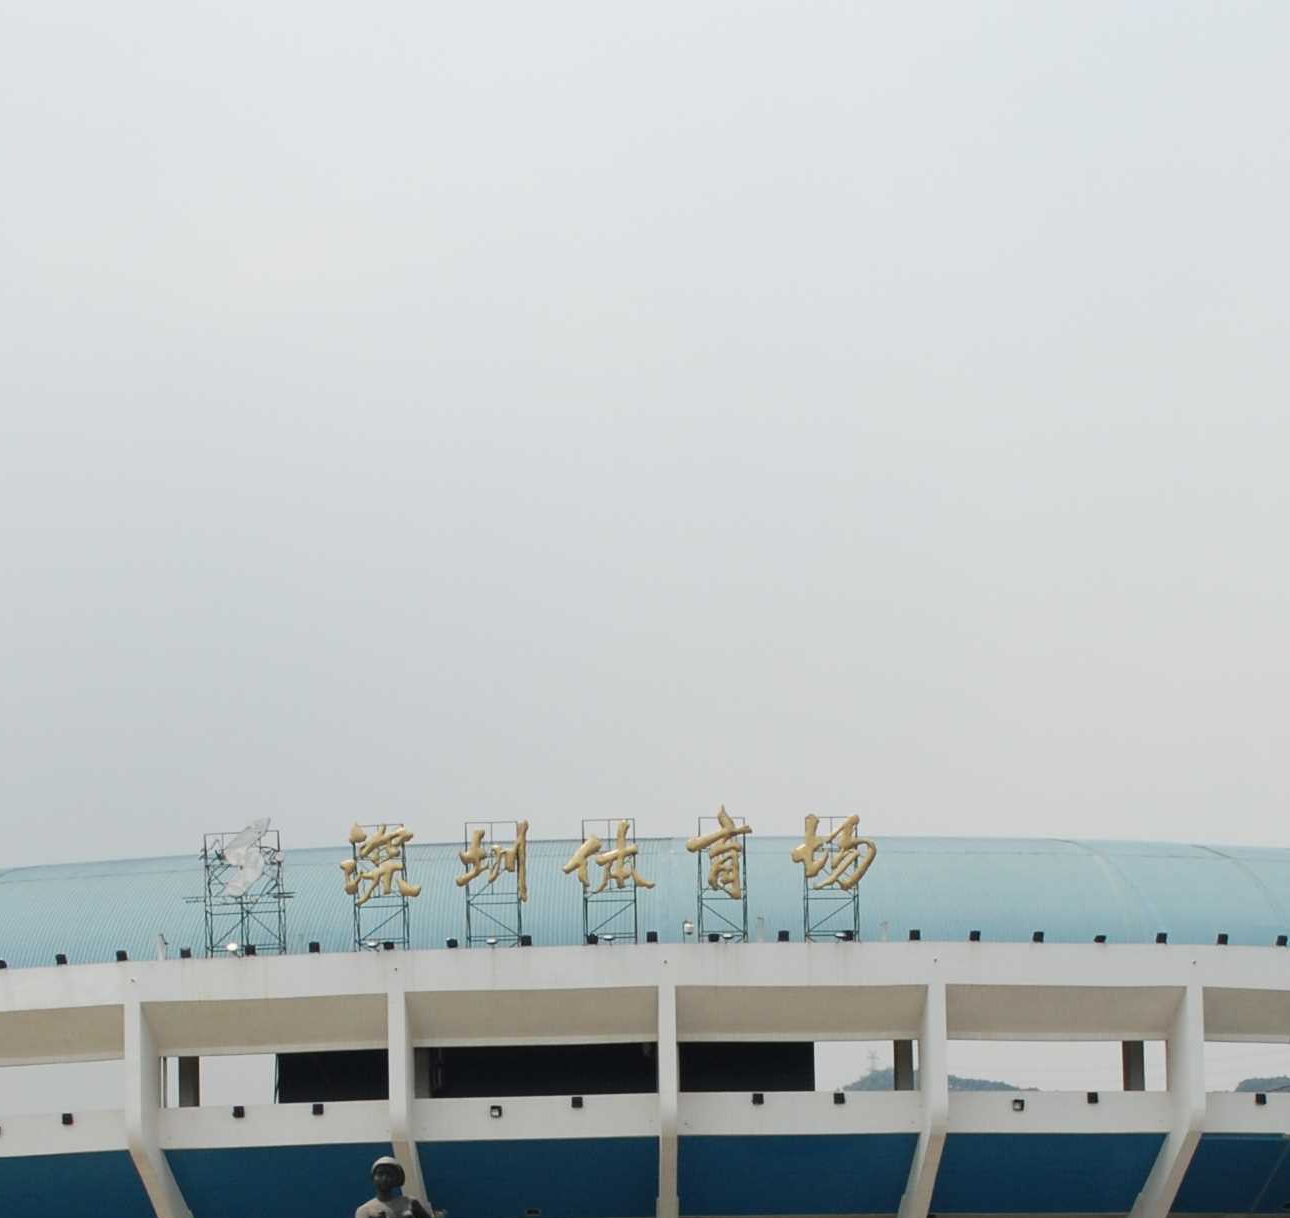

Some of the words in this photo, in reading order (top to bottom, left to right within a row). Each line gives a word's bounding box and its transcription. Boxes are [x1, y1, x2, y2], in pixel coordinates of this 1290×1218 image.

[339, 805, 877, 906] 深圳体育场
